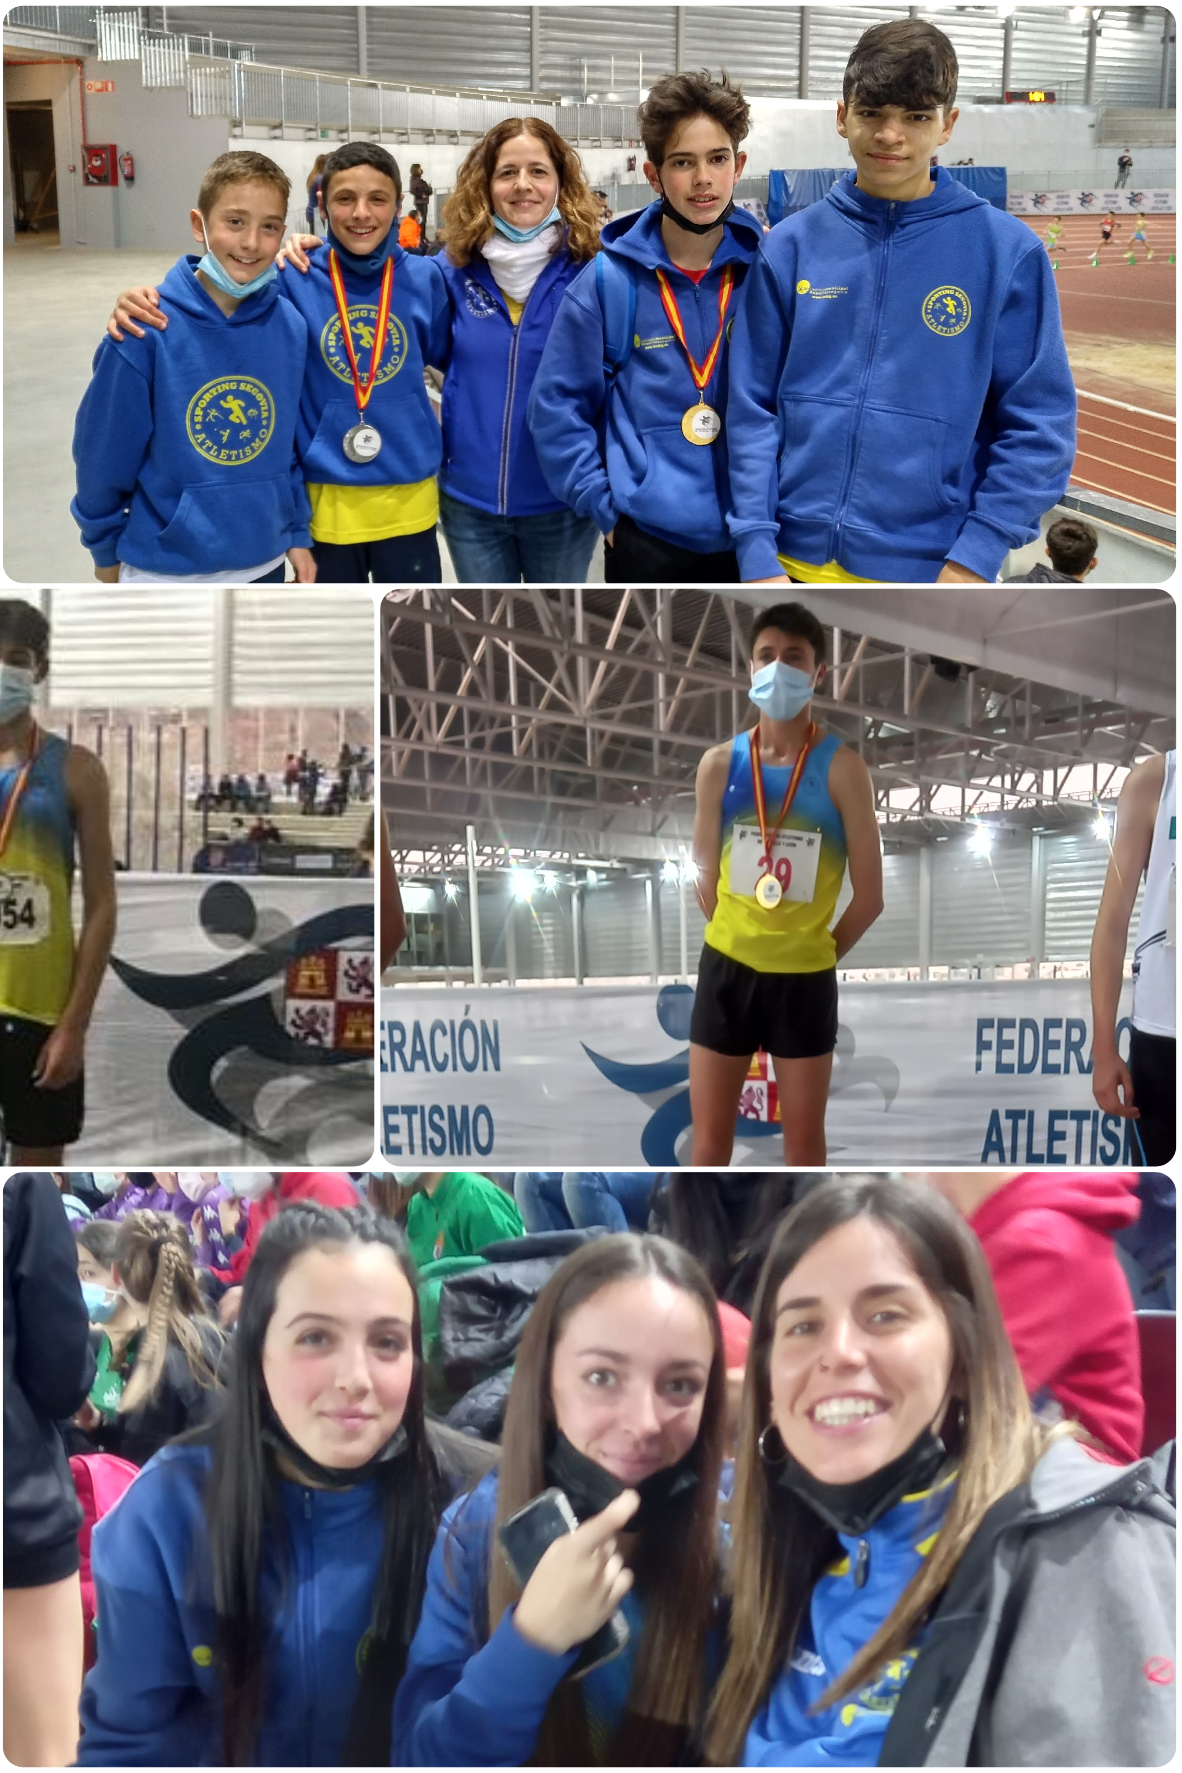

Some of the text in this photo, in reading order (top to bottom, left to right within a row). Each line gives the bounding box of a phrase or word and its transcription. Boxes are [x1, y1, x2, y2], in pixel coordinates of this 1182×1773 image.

[328, 309, 401, 347] SPORING SOVIA
[329, 354, 400, 383] ATLTSMO
[193, 381, 269, 423] SPORTING SEGOVIA
[194, 428, 268, 460] ATLETISMO
[380, 1104, 495, 1156] ETISMO
[980, 1109, 1132, 1166] ATLETIS
